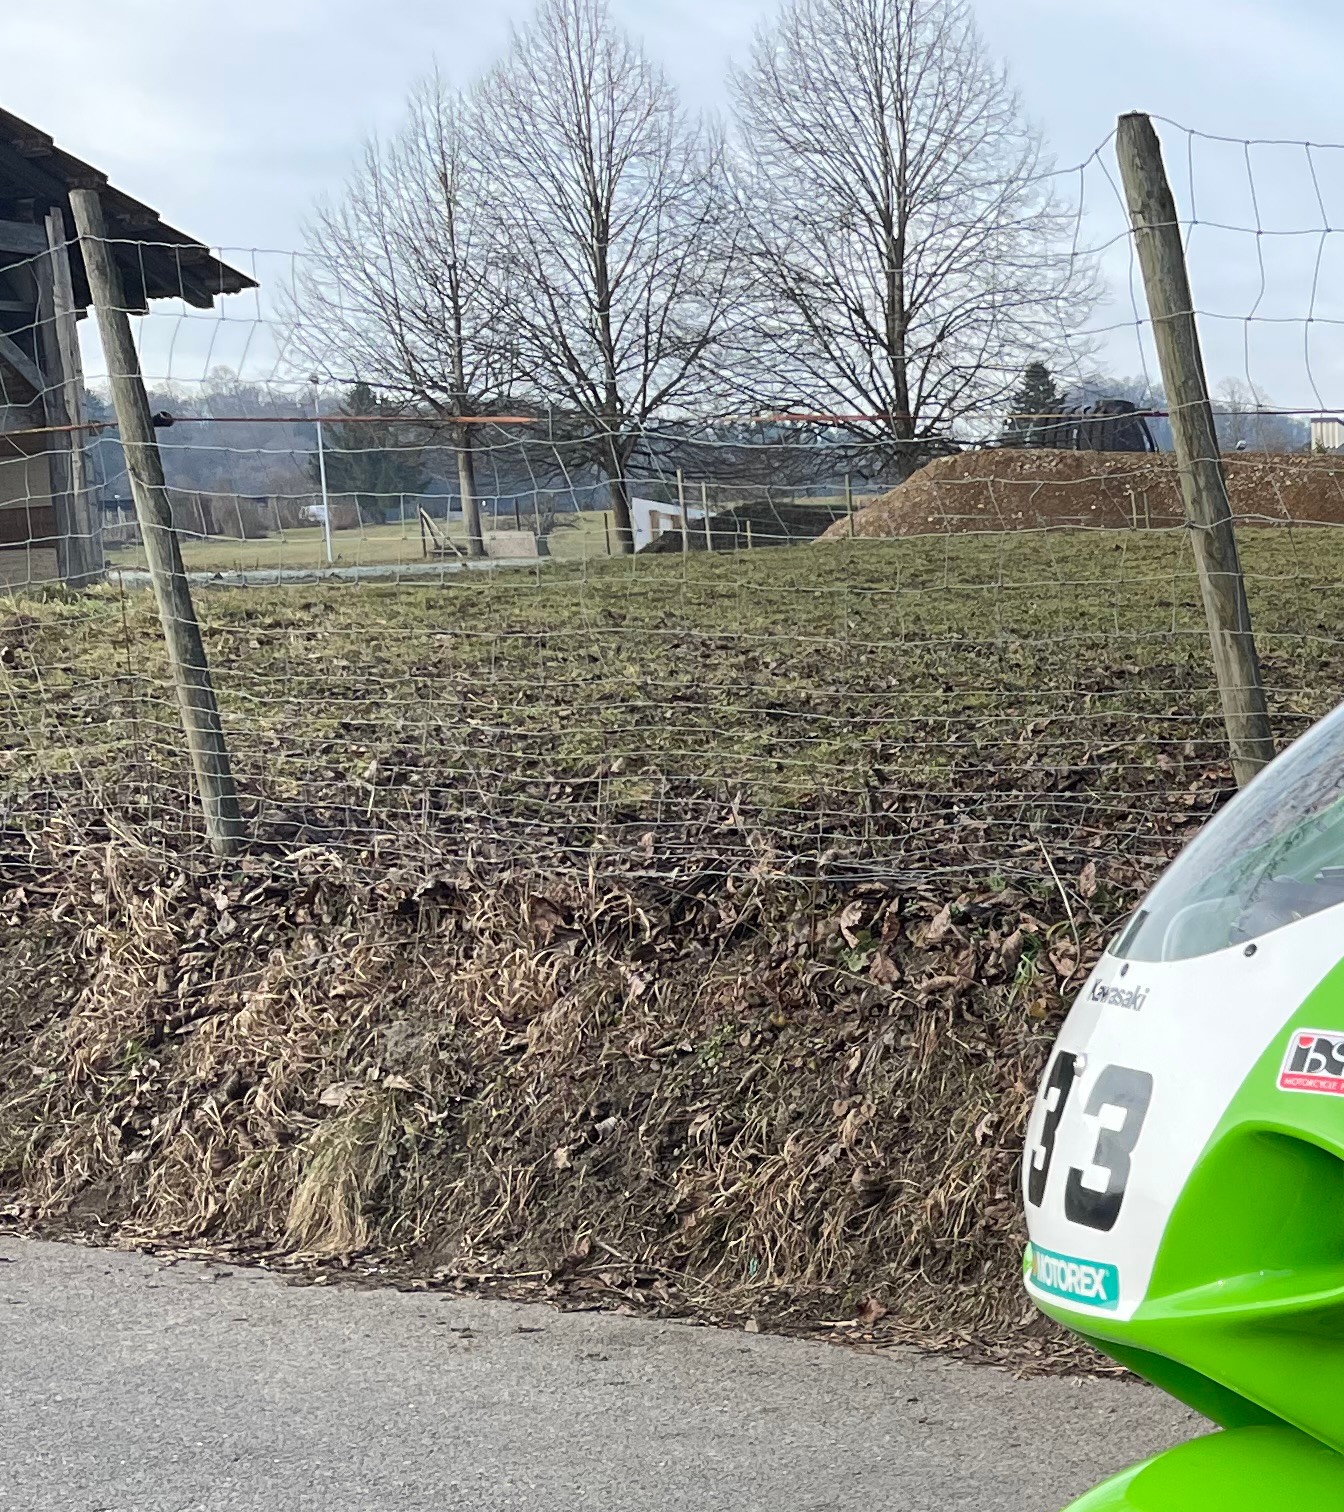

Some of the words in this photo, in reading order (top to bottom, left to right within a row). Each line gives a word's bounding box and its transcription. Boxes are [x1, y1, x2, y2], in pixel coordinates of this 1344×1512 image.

[1091, 978, 1150, 1012] Kawasaki
[1284, 1078, 1338, 1091] MOTORCYCLE
[1028, 1049, 1154, 1232] 33
[1036, 1251, 1109, 1301] MOTOREX
